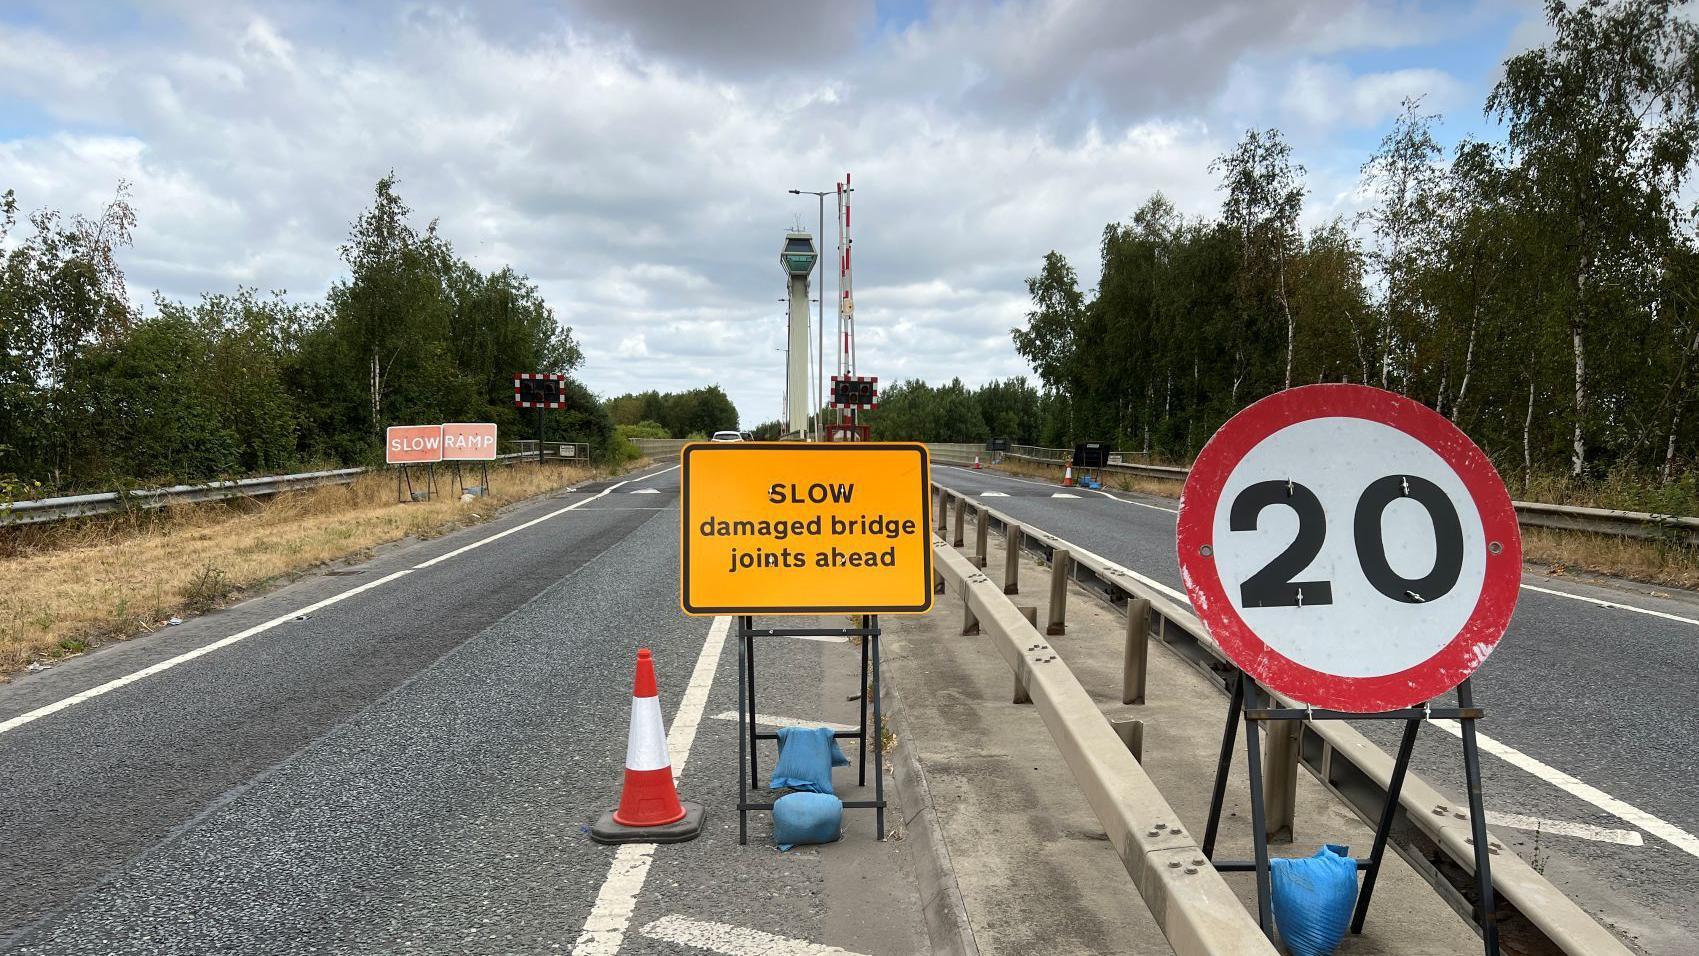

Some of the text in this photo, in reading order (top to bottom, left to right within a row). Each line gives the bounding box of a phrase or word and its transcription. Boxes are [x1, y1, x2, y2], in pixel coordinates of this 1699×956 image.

[391, 437, 440, 451] SLOW
[445, 435, 494, 448] RAMP
[768, 483, 855, 504] SLOW
[700, 515, 916, 540] damaged bridge
[1229, 474, 1465, 609] 20
[729, 547, 896, 573] joints ahead
